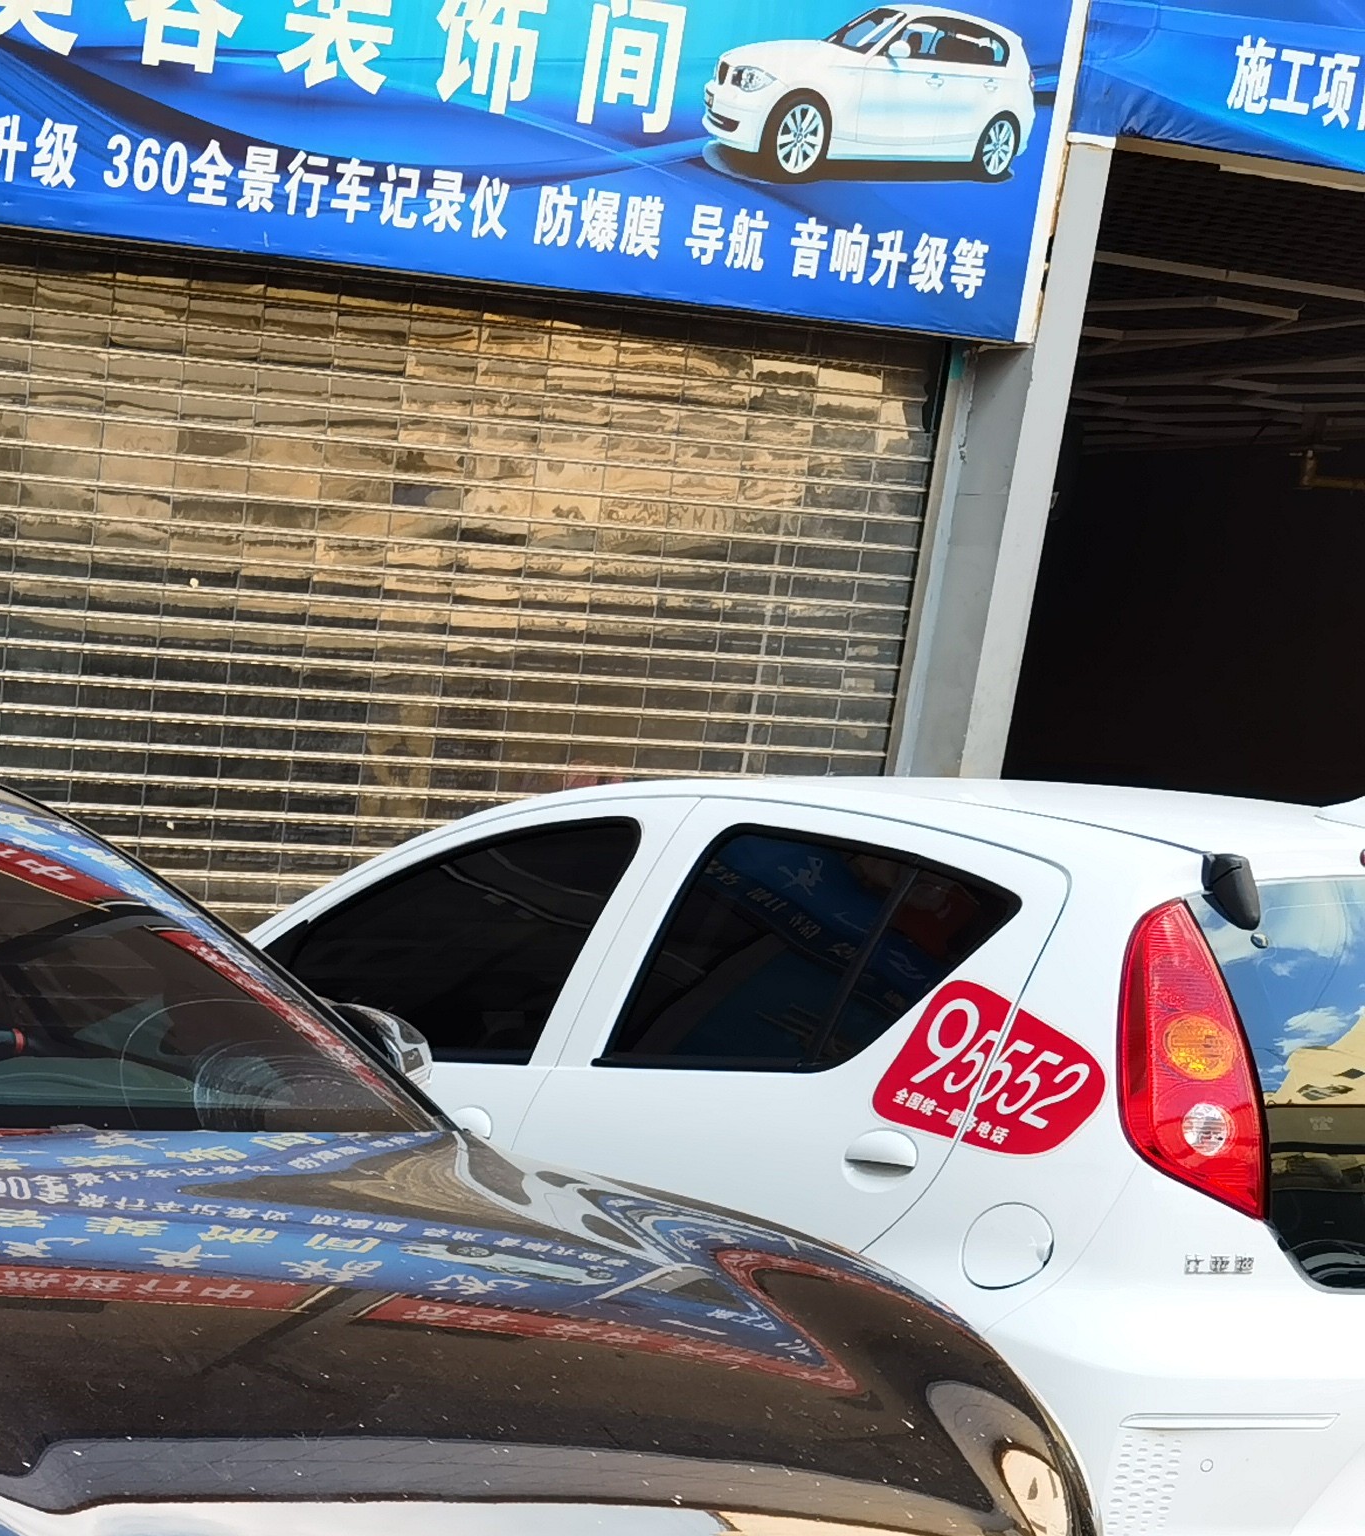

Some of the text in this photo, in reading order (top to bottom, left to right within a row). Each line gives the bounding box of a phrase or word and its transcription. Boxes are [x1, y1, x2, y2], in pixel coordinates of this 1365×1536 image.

[1227, 35, 1365, 131] 施工项
[103, 135, 509, 241] 360全景行车记录仪
[534, 186, 664, 260] 防爆膜
[684, 204, 771, 274] 导航
[790, 215, 990, 300] 音响升级等
[910, 998, 1091, 1130] 95552
